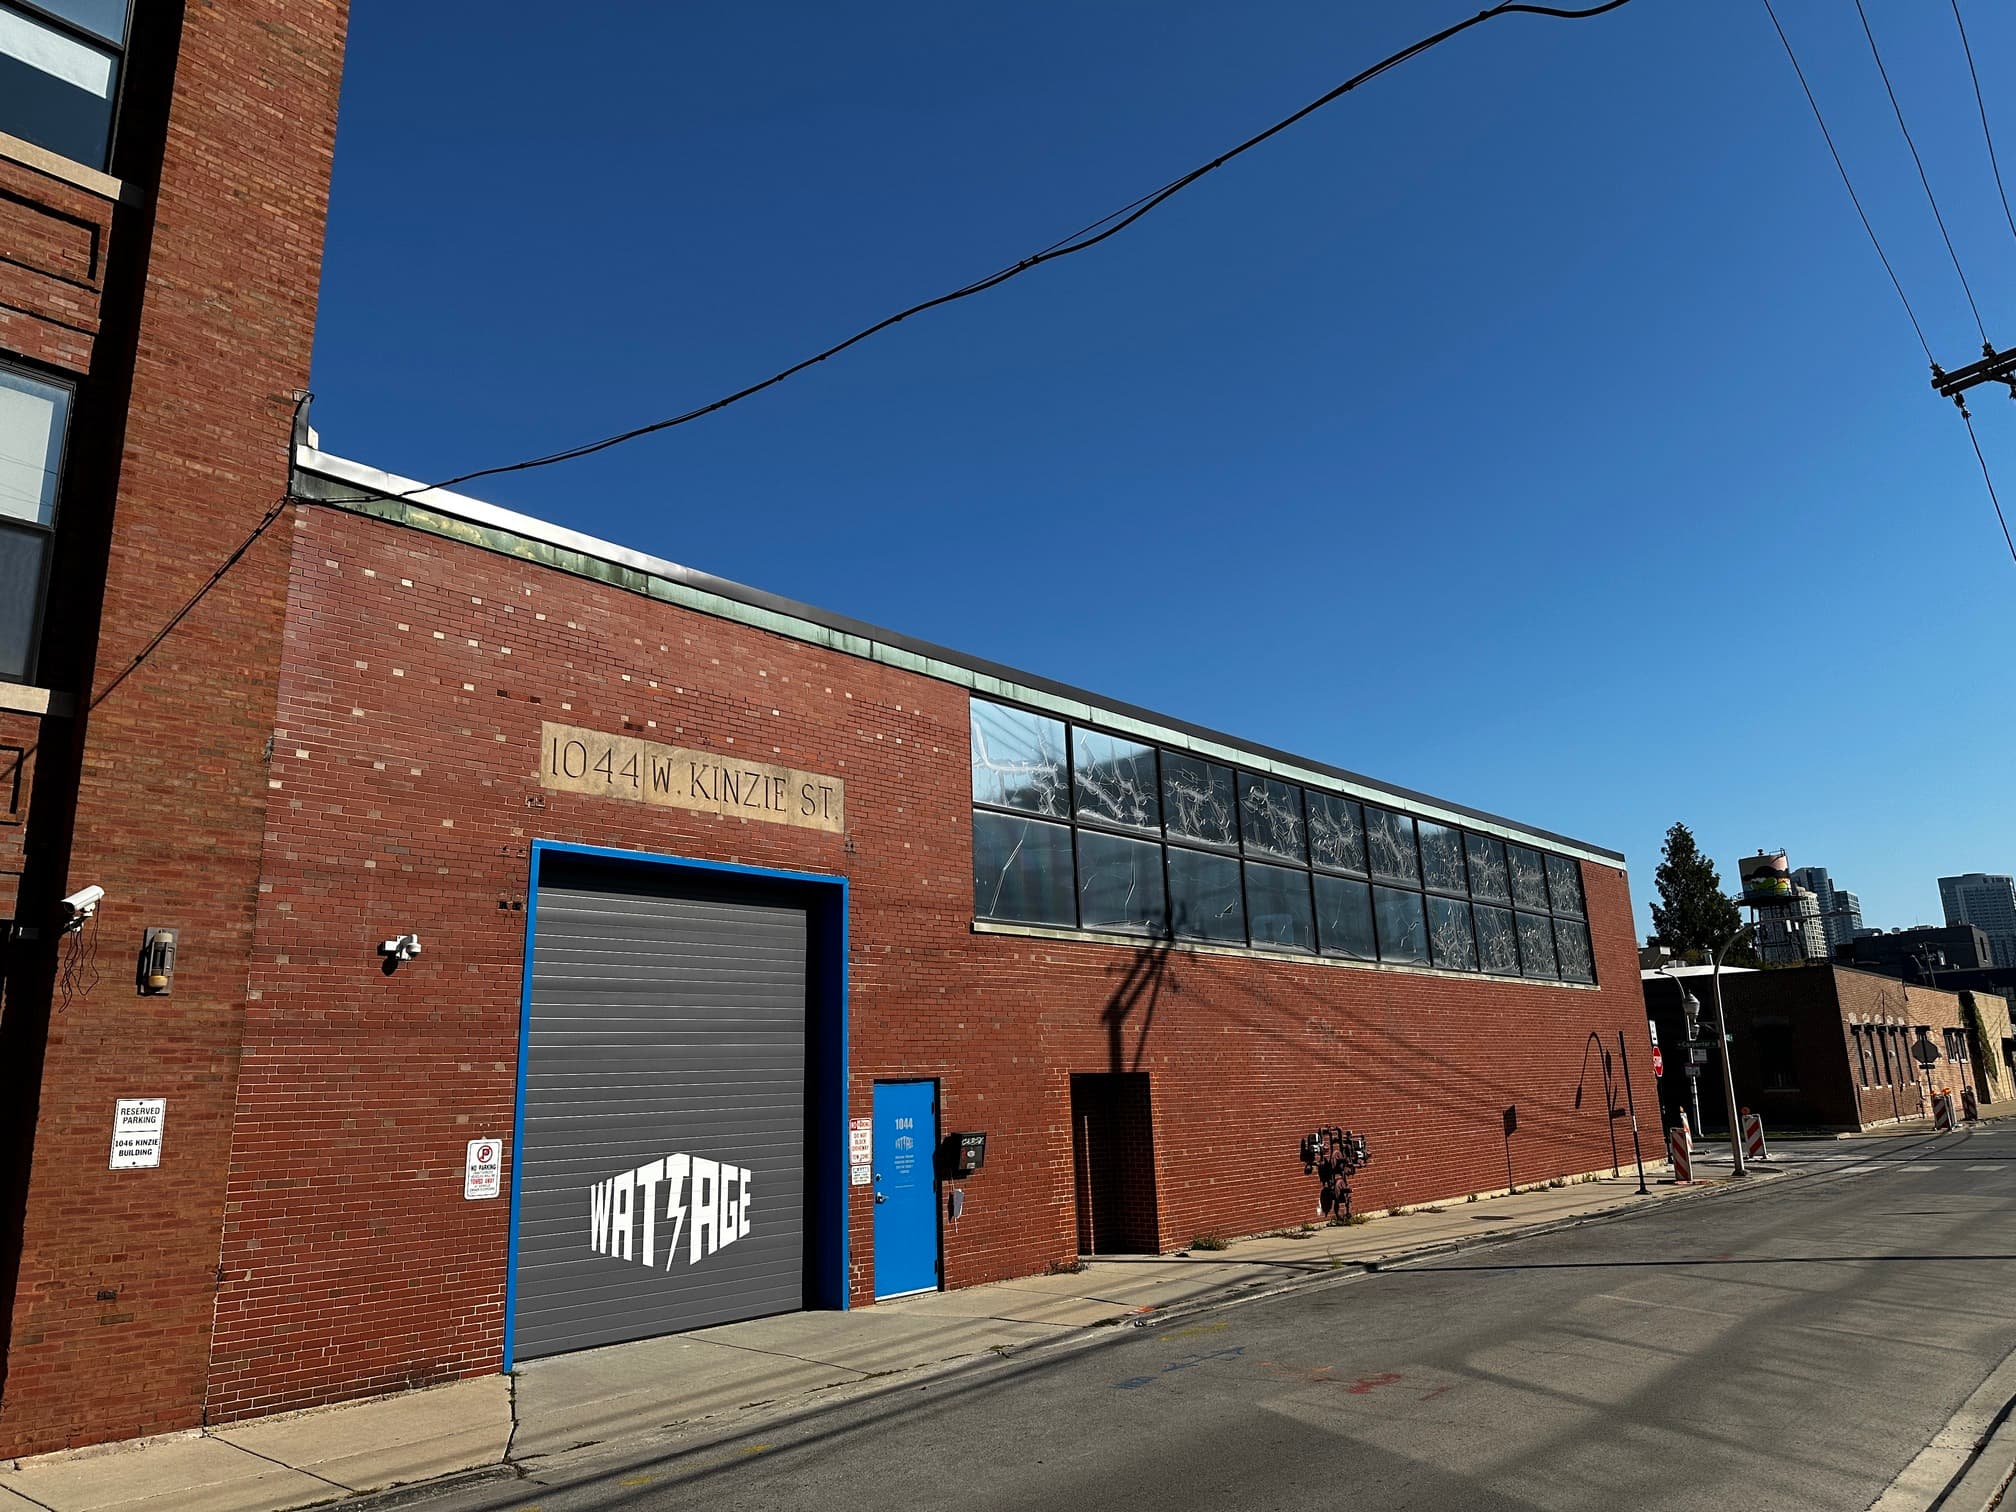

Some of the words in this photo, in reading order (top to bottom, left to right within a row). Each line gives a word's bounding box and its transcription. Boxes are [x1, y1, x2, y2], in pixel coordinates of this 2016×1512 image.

[551, 737, 639, 788] 1044
[651, 755, 682, 795] W.
[690, 762, 787, 812] KINZIE
[801, 783, 840, 821] ST.
[121, 1107, 161, 1116] RESERVED
[123, 1116, 156, 1124] PARKING
[895, 1117, 913, 1130] 1044
[118, 1148, 152, 1157] BUILDING
[591, 1153, 751, 1272] WATTAGE
